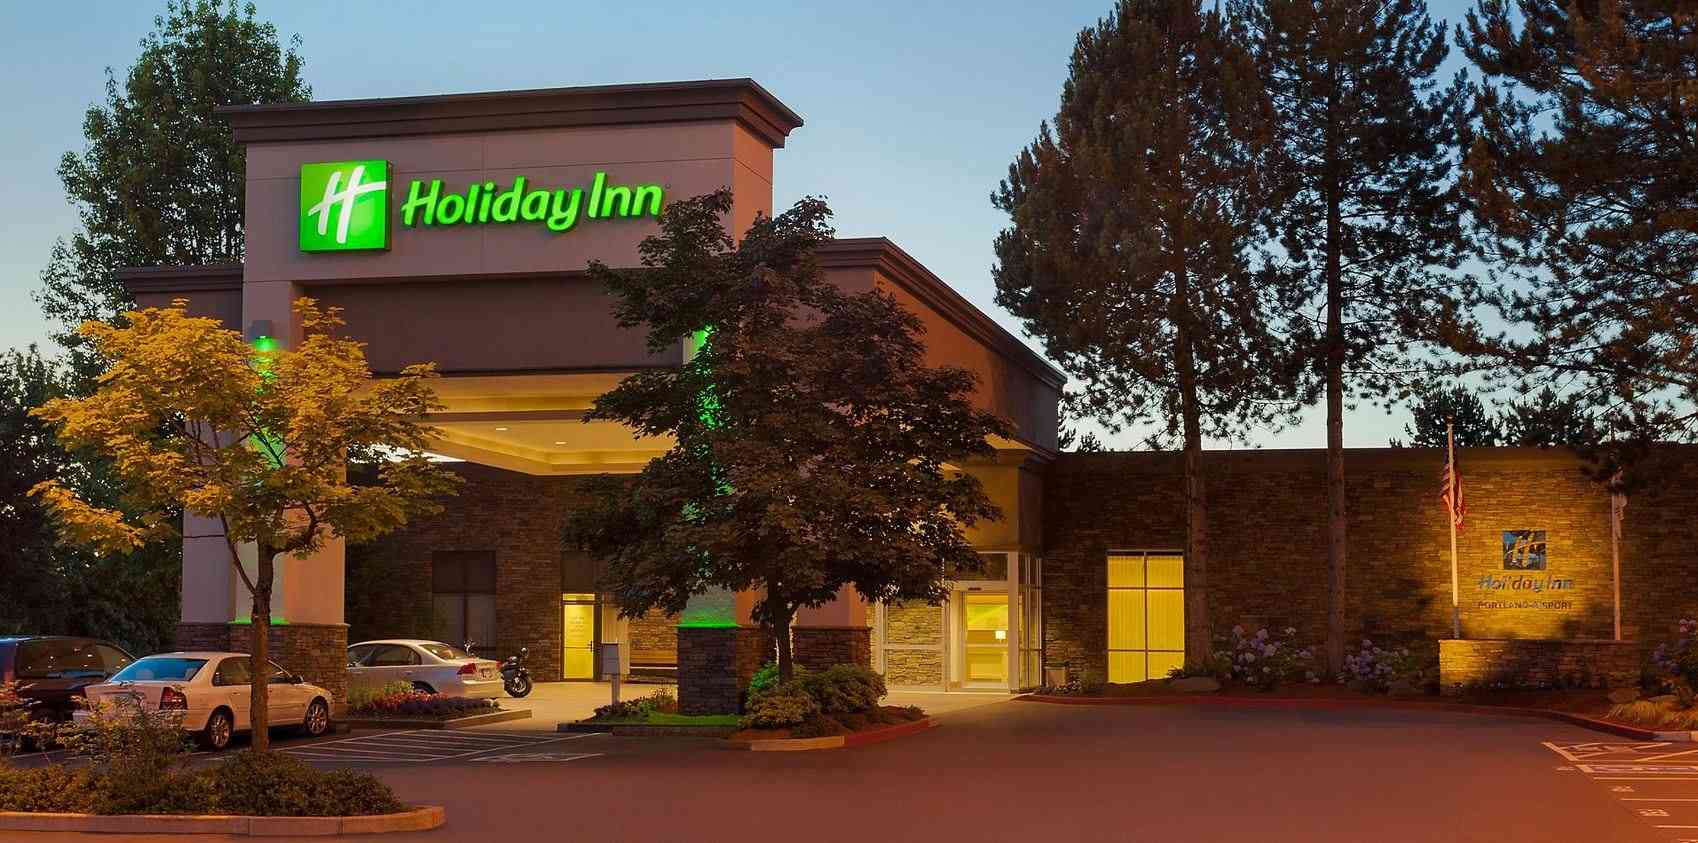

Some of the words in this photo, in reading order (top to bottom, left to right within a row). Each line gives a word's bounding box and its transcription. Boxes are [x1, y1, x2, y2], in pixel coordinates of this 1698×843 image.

[401, 176, 583, 233] Holiday
[588, 172, 664, 219] Inn
[1478, 575, 1543, 593] Holiday
[1547, 574, 1574, 590] Inn
